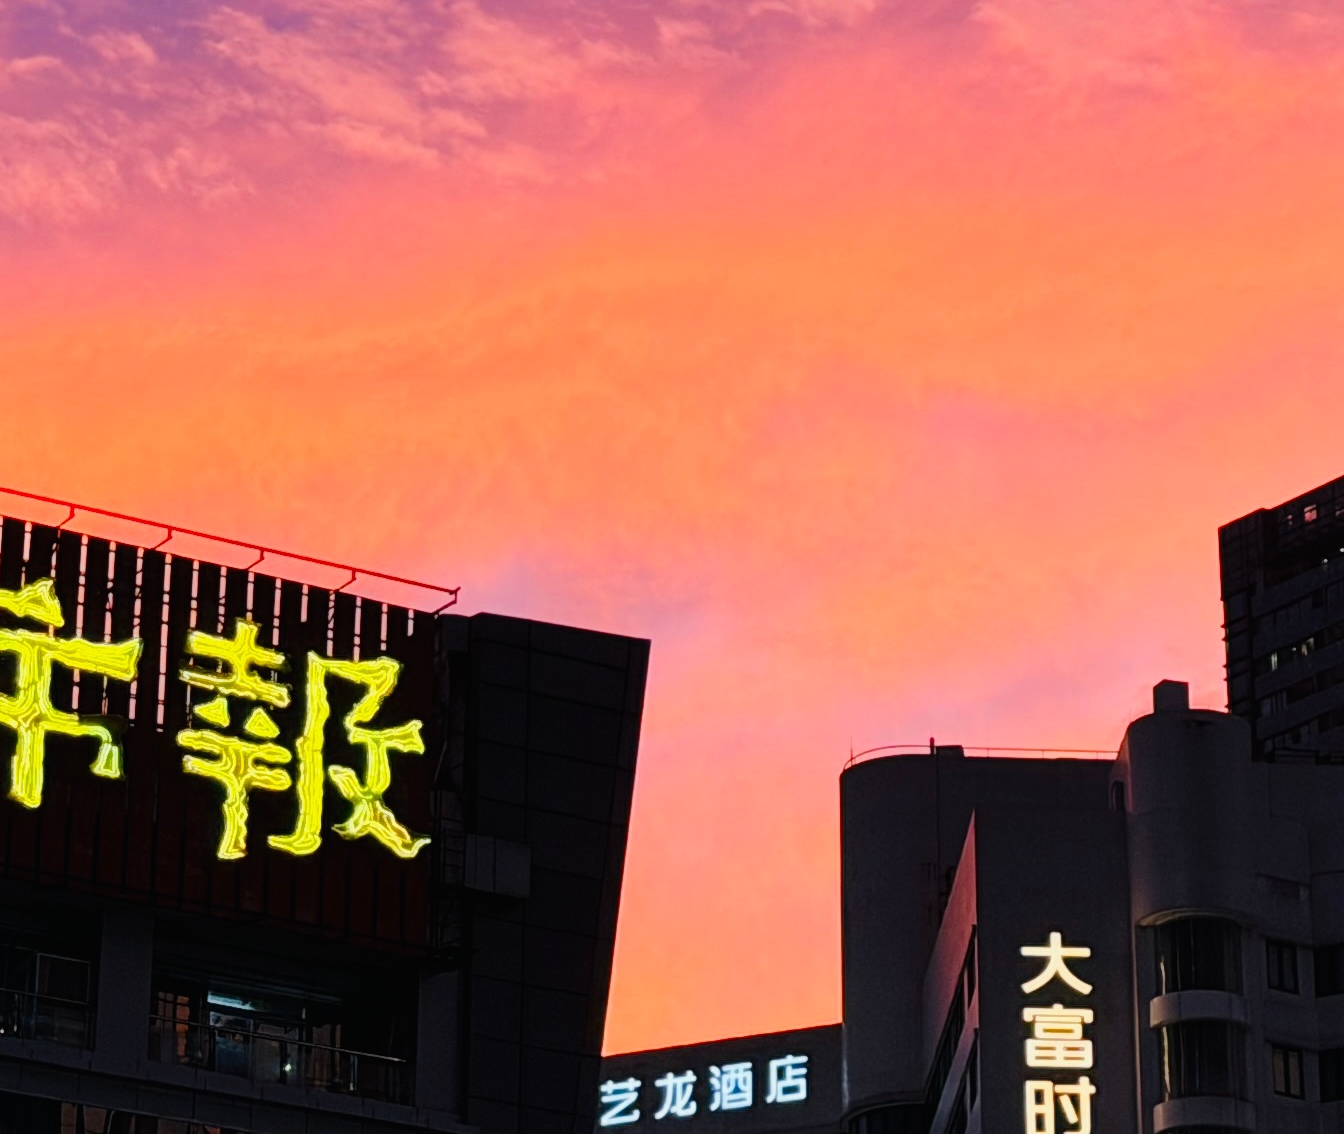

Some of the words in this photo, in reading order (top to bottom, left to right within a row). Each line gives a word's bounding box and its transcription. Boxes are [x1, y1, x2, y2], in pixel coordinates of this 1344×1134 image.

[599, 1055, 809, 1126] 艺龙酒店
[1020, 931, 1097, 1134] 大富时
